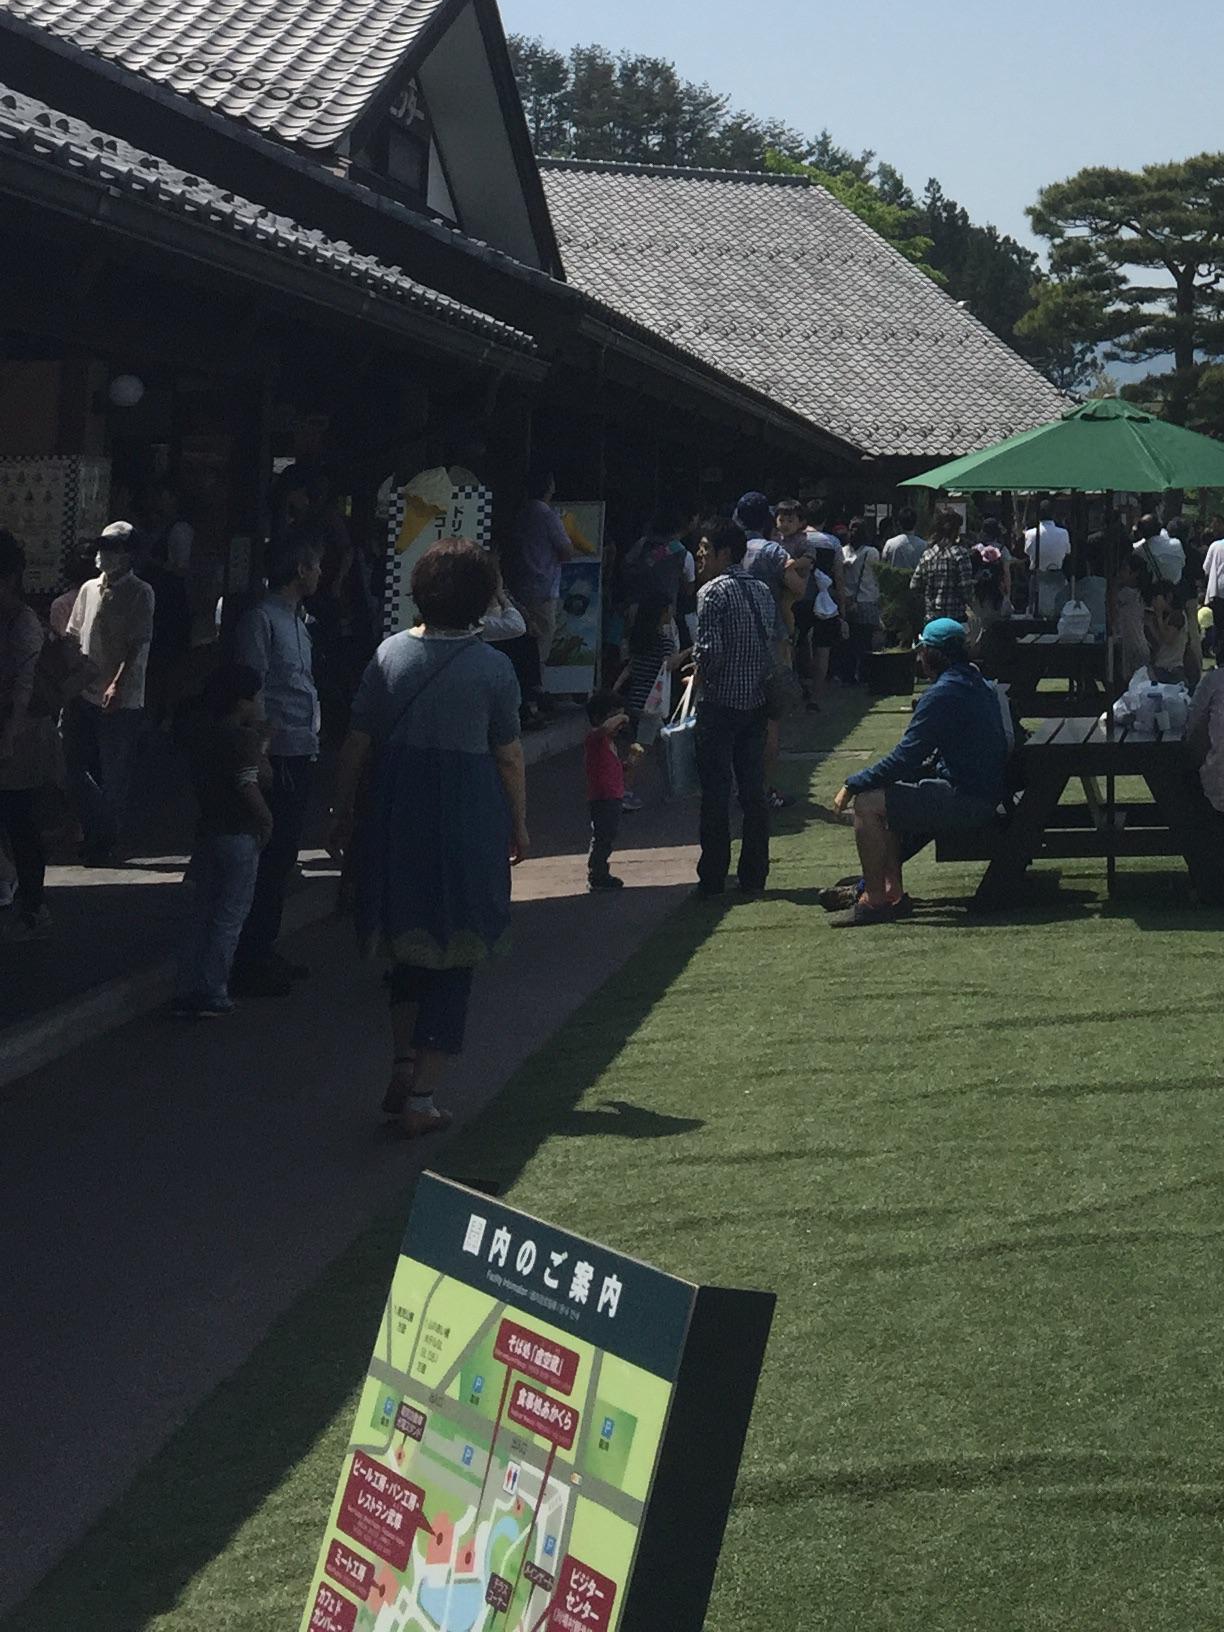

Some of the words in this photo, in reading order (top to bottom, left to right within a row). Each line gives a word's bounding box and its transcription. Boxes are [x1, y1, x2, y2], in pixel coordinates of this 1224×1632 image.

[462, 1213, 623, 1318] 園内のご案内
[570, 1568, 604, 1599] ビジター
[566, 1591, 599, 1620] センター
